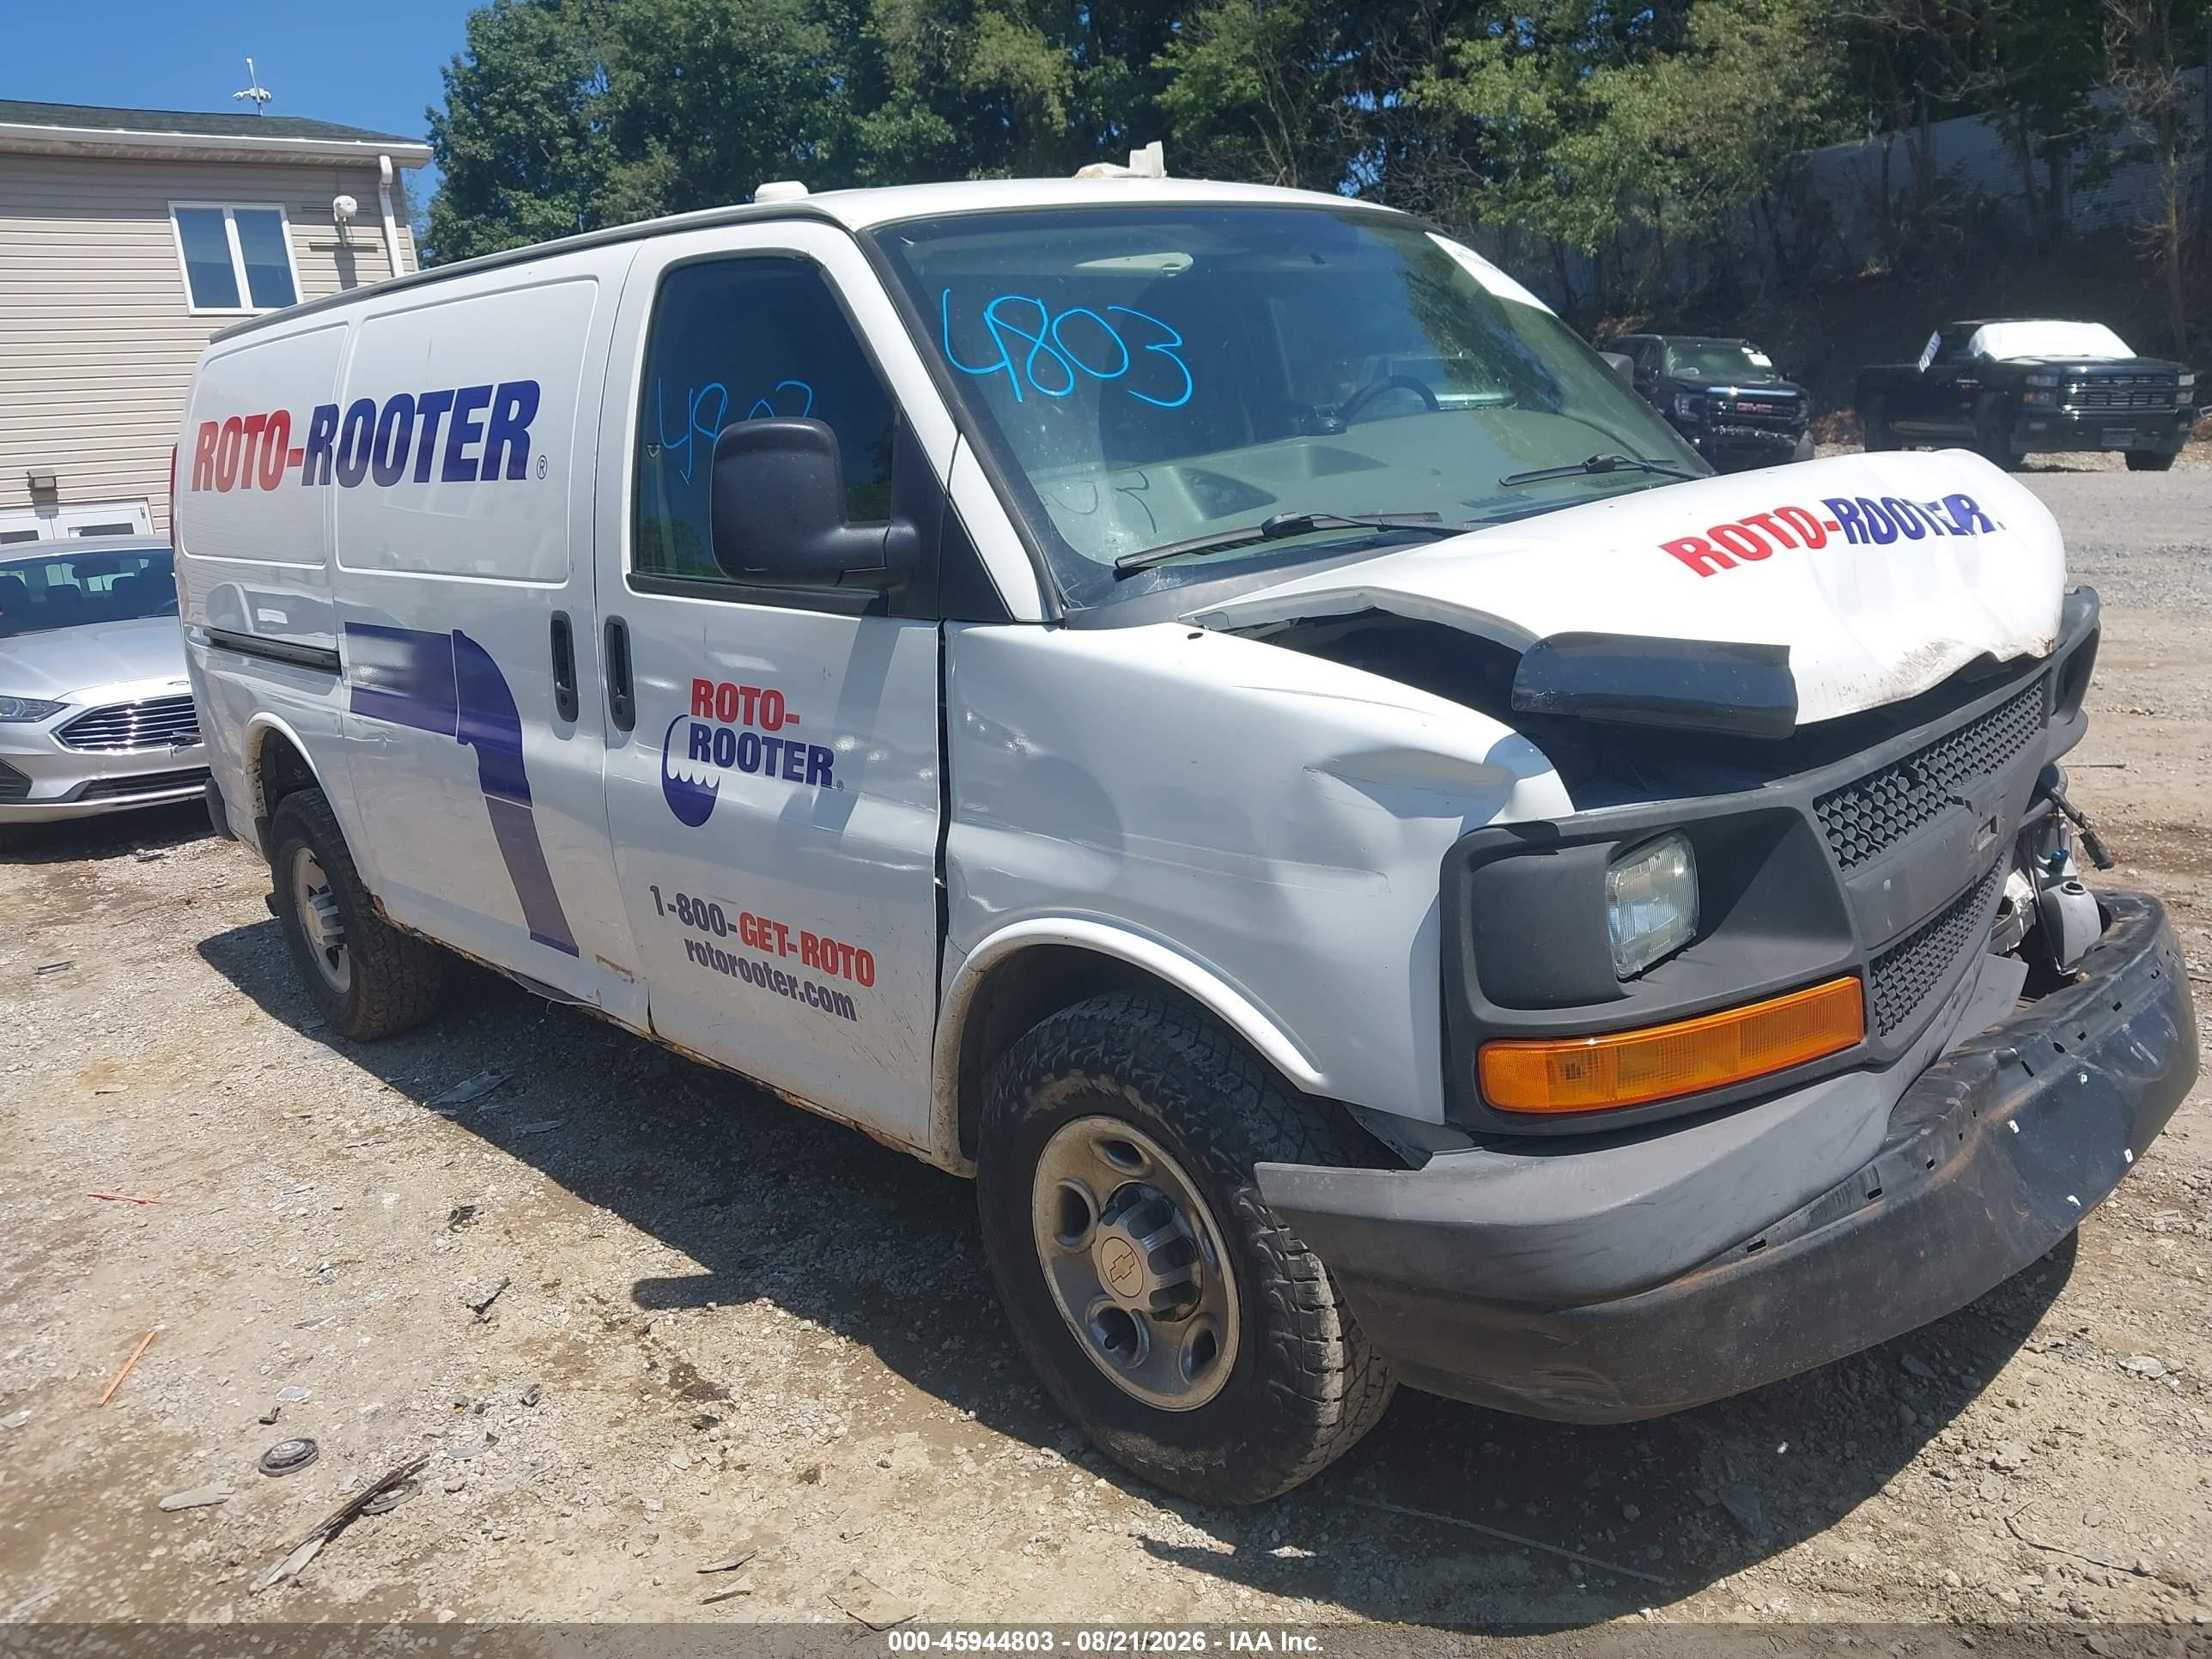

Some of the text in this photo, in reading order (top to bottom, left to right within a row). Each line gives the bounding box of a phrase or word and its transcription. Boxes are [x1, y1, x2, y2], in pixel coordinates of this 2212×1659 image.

[942, 289, 1194, 408] 4803
[191, 379, 541, 494] ROTO-ROOTER
[690, 678, 800, 731] ROTO-
[689, 722, 835, 787] ROOTER
[649, 884, 876, 988] 1-800-GET-ROTO
[684, 937, 857, 1021] rotorooter.com
